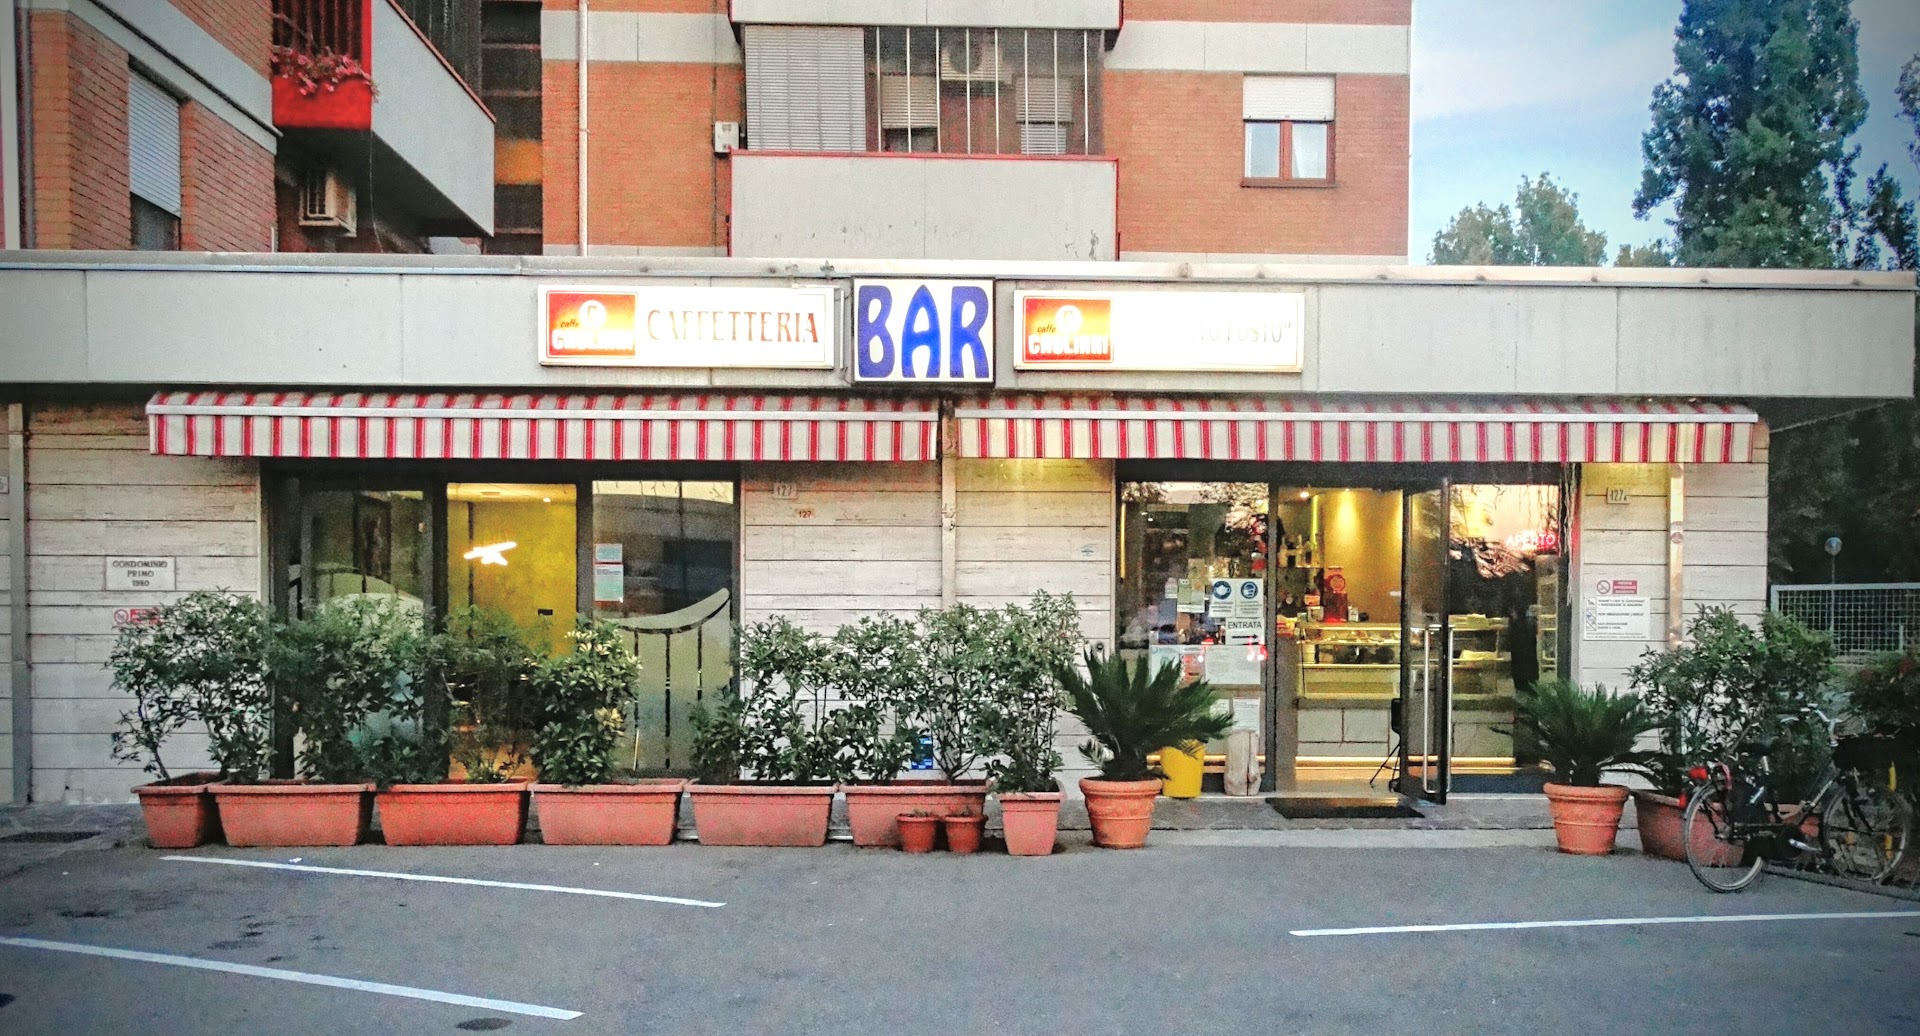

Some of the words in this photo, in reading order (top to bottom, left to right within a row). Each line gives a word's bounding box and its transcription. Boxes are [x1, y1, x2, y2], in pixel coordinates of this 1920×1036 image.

[857, 284, 990, 379] BAR
[1505, 533, 1556, 547] APERTO
[1227, 621, 1262, 630] ENTRATA
